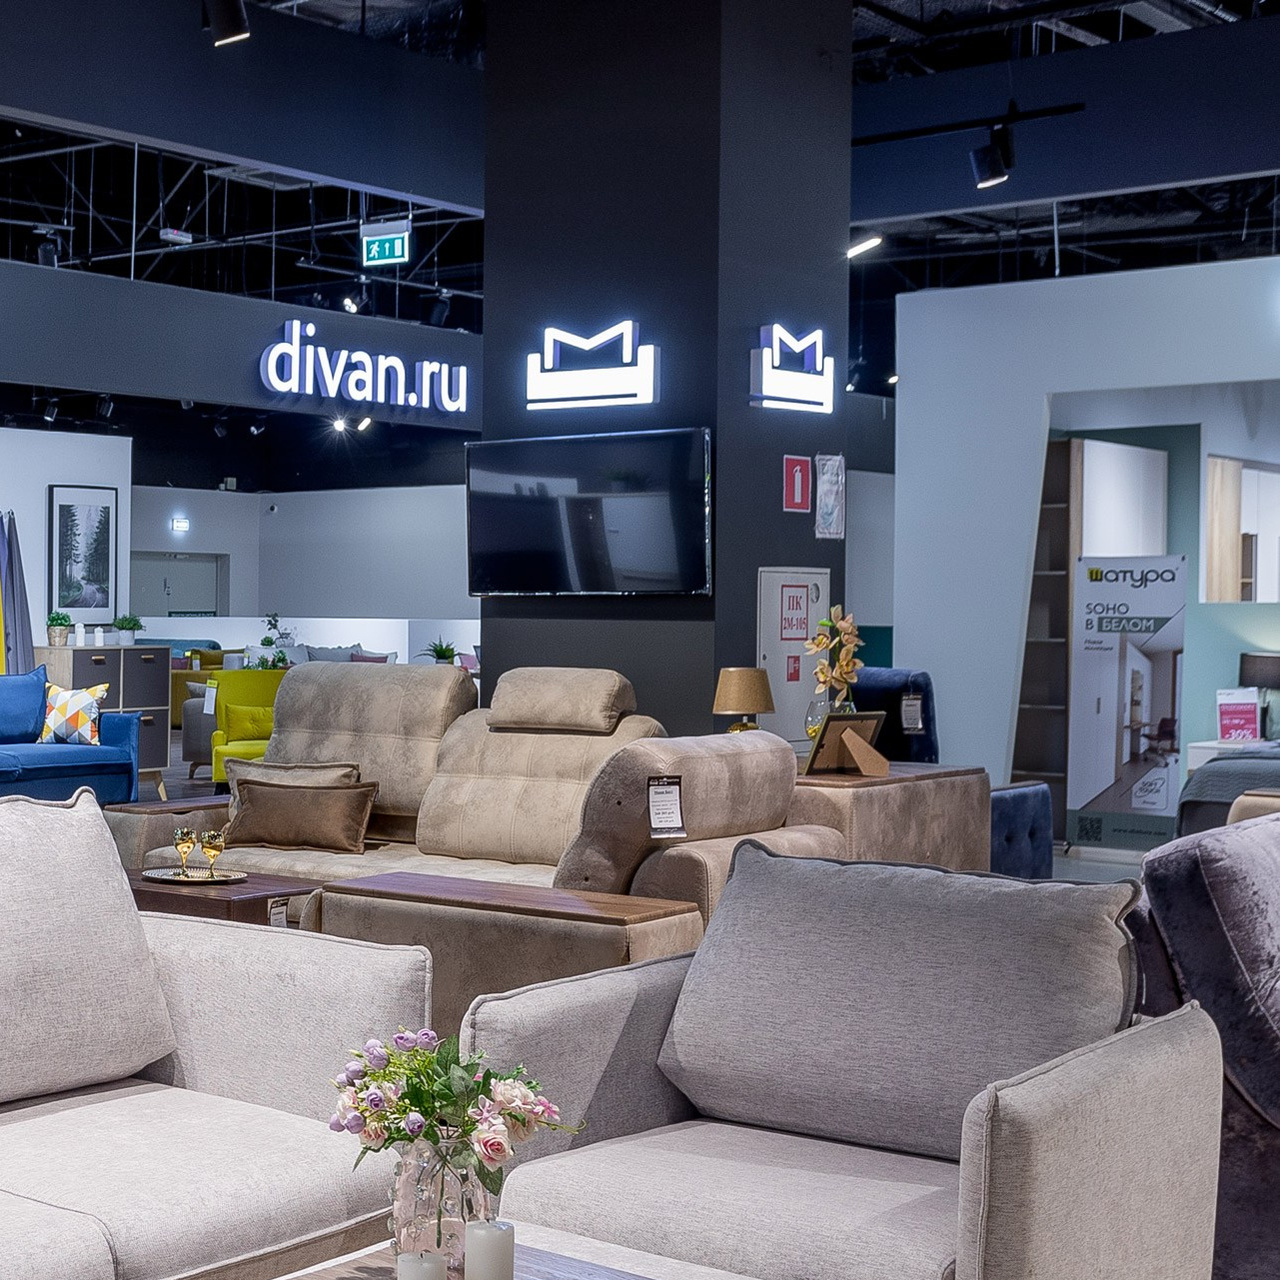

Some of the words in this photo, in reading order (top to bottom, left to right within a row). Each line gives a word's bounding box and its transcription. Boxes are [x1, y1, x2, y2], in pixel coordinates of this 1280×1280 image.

[264, 319, 468, 412] divan.ru
[787, 595, 803, 611] ПК
[1085, 602, 1130, 615] SOHO
[1085, 618, 1094, 631] В
[1101, 618, 1155, 632] БЕЛОМ
